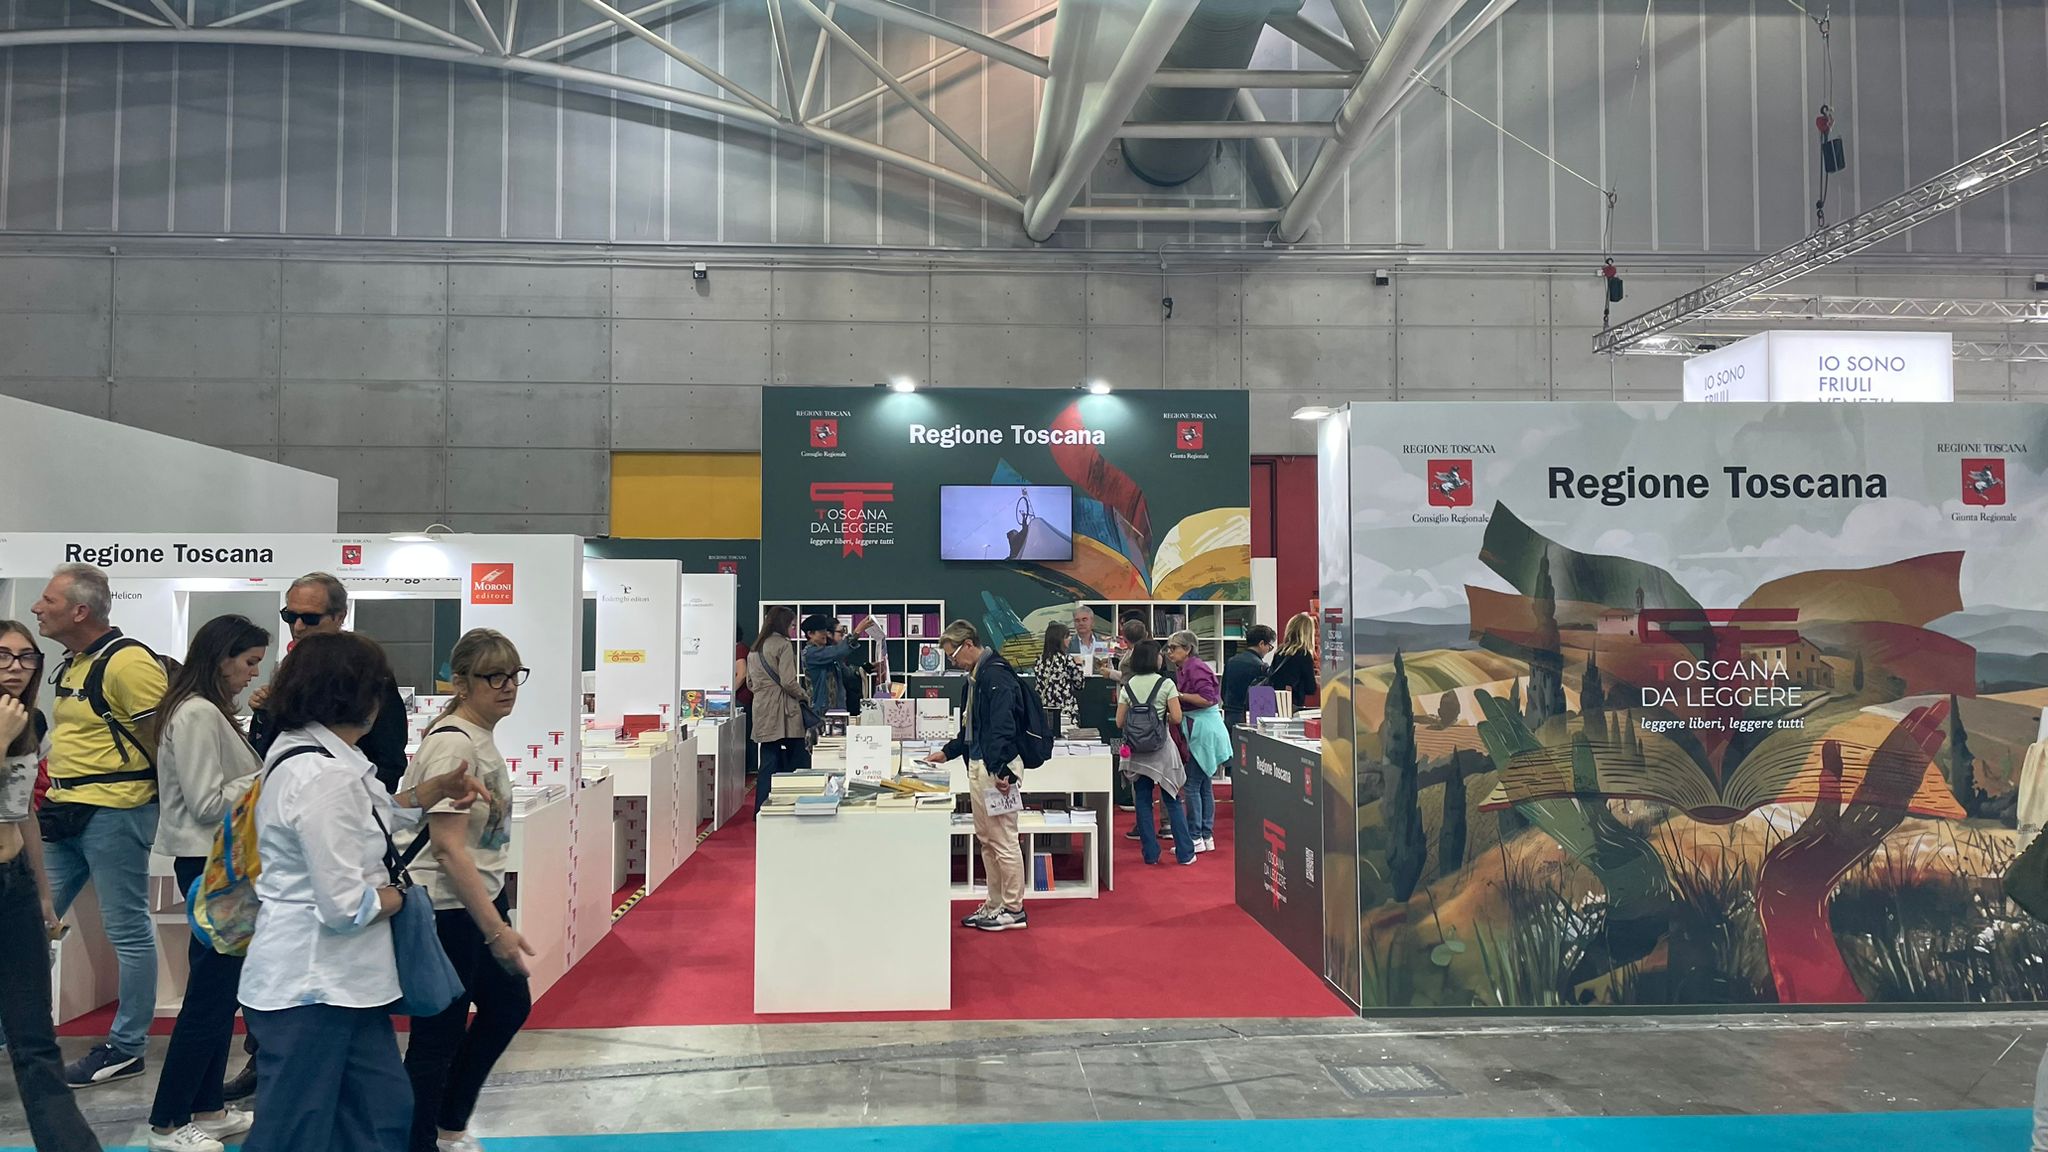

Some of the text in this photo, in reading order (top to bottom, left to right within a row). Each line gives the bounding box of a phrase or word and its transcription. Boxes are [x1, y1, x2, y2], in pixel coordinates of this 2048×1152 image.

[1818, 356, 1906, 372] IO SONO
[1704, 364, 1746, 391] IO SONO
[1818, 377, 1872, 392] FRIULI
[909, 424, 1106, 448] Regione Toscana
[1402, 444, 1496, 454] REGIONE TOSCANA
[1937, 443, 2028, 453] REGIONE TOSCANA
[1548, 466, 1888, 507] Regione Toscana
[1412, 513, 1490, 525] Consiglio Regionale
[1951, 512, 2017, 523] Giunta Regionale
[810, 522, 894, 534] DA LEGGERE
[810, 538, 834, 547] leggere
[855, 538, 878, 547] leggere
[65, 543, 274, 567] Regione Toscana
[474, 581, 512, 591] MORONI
[112, 591, 143, 600] Helicon
[475, 592, 511, 600] editore
[1641, 687, 1803, 707] DA LEGGERE
[1641, 716, 1805, 732] leggere liberi, leggere tutti
[1256, 755, 1291, 784] Regione Toscana
